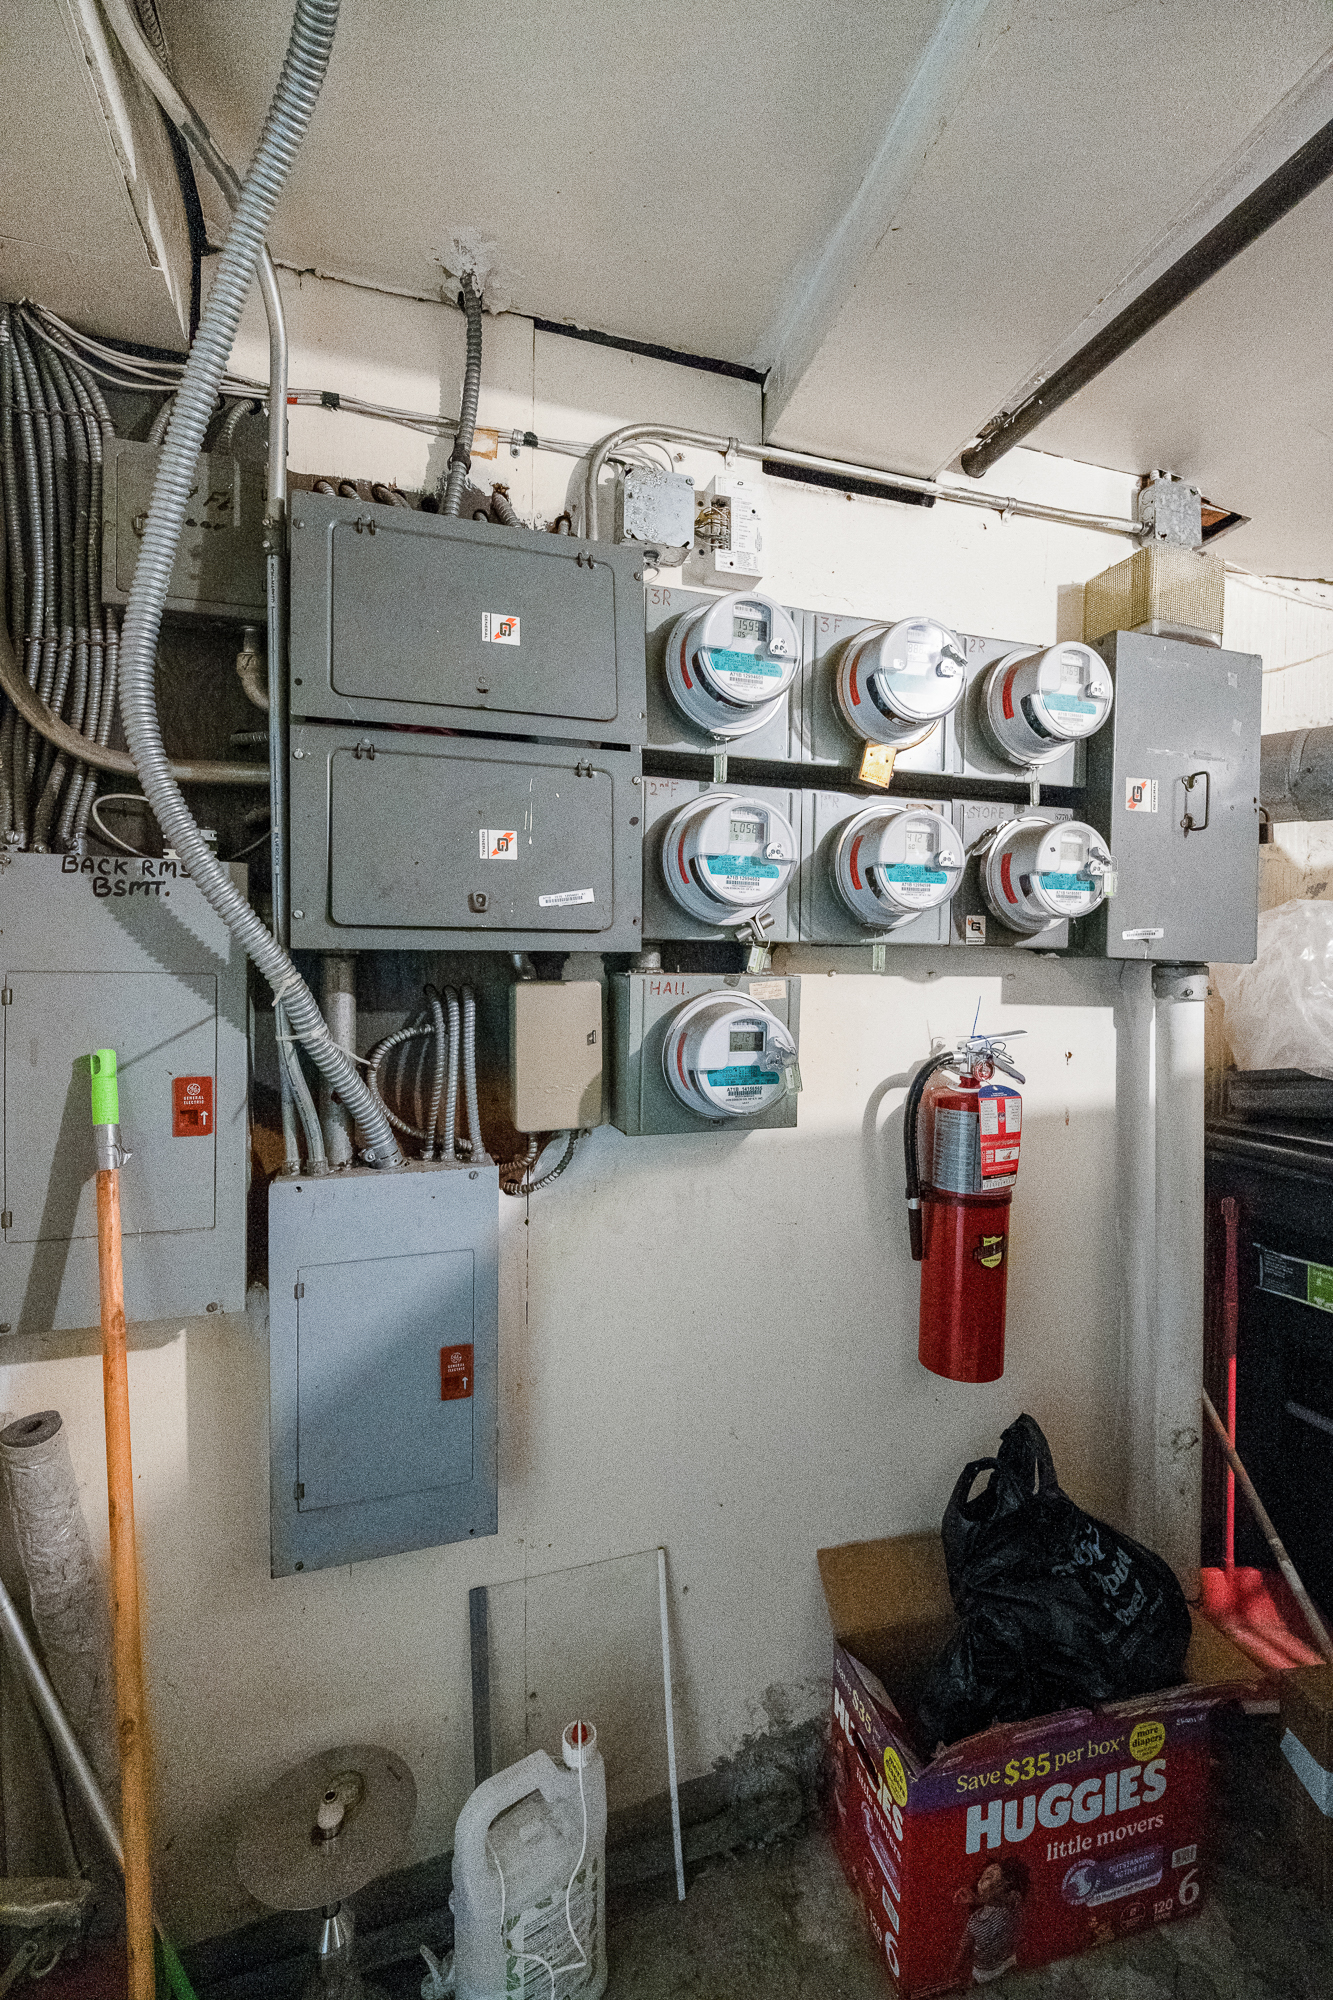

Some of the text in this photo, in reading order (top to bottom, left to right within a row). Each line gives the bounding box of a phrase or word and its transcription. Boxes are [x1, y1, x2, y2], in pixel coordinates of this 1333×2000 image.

[650, 588, 672, 606] 3R
[968, 638, 986, 653] 2R
[967, 806, 1005, 819] STORE
[61, 854, 129, 874] BACK
[92, 876, 171, 898] BSMT.
[1132, 1734, 1163, 1748] diapers
[1137, 1726, 1159, 1737] more
[955, 1770, 1002, 1794] Save
[1003, 1751, 1052, 1787] $35
[1054, 1747, 1086, 1772] per
[965, 1758, 1167, 1855] HUGGIES
[1046, 1813, 1164, 1862] little movers
[1108, 1852, 1156, 1873] OUTSTANDING
[1178, 1867, 1200, 1906] 6
[1153, 1897, 1174, 1914] 120
[884, 1930, 900, 1978] 6
